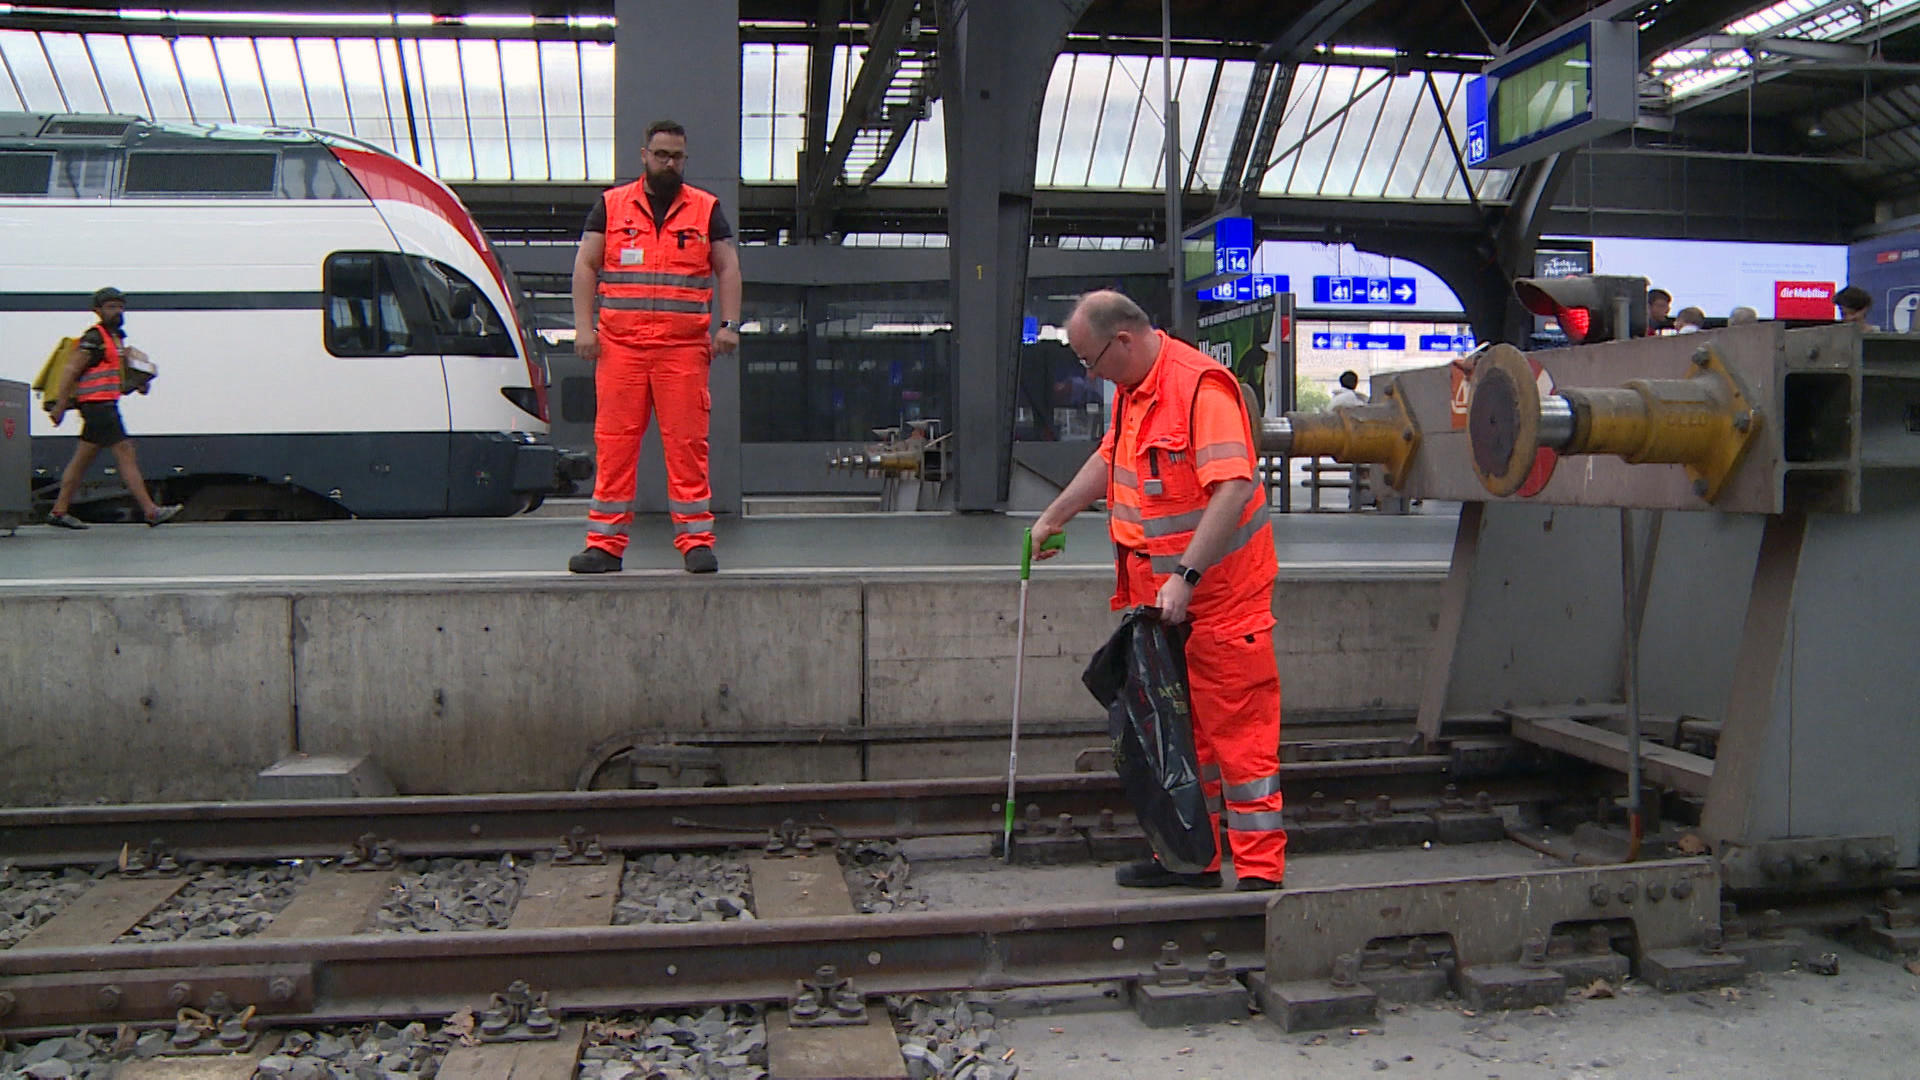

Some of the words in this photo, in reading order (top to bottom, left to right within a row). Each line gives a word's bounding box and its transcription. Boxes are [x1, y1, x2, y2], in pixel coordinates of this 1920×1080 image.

[1471, 137, 1483, 158] 13
[1230, 256, 1246, 270] 14
[1217, 282, 1232, 296] 16
[1255, 284, 1272, 297] 18
[1333, 285, 1348, 298] 41
[1370, 286, 1387, 300] 44
[1780, 287, 1793, 298] die
